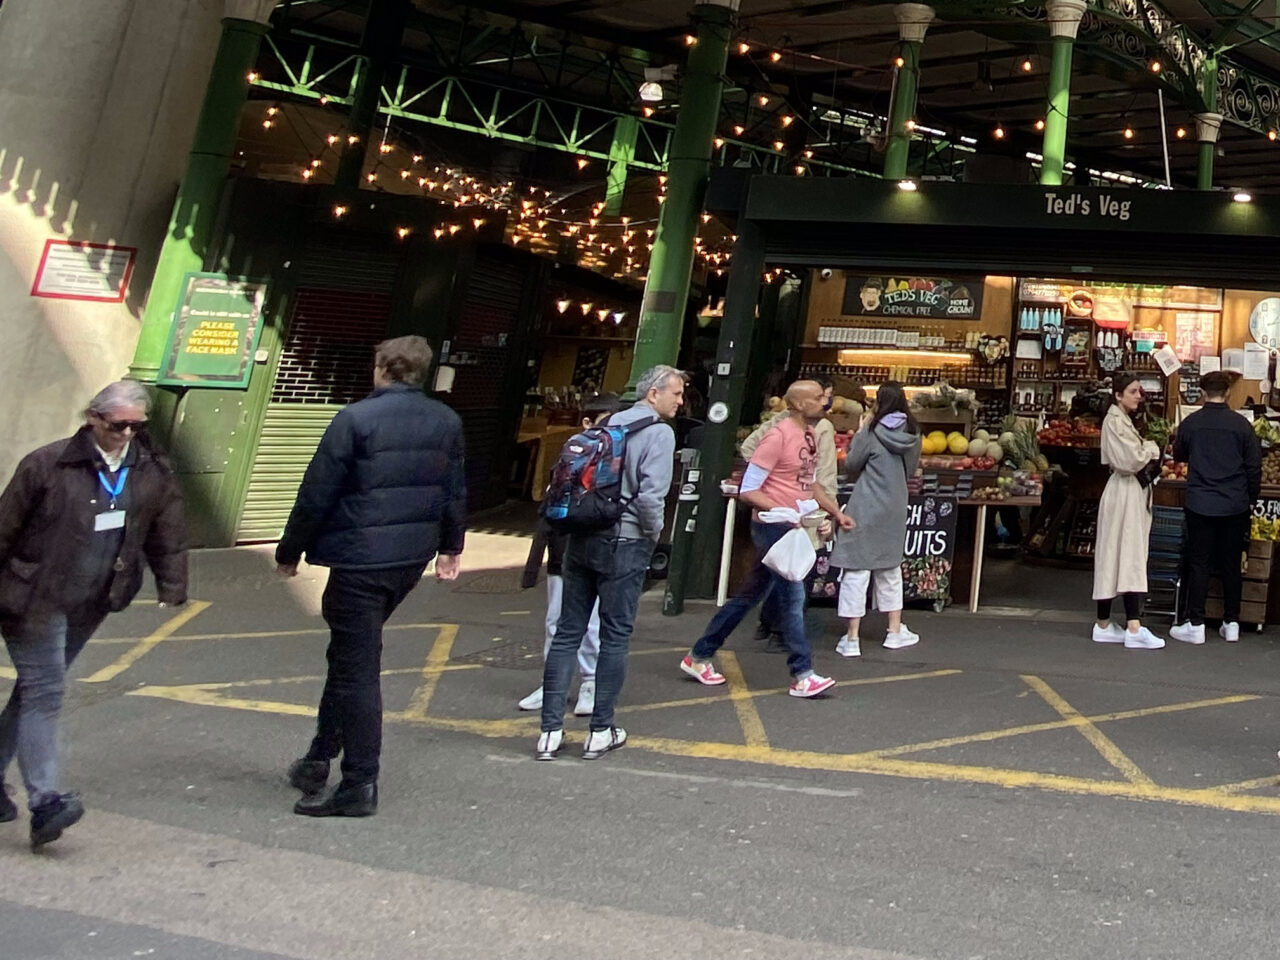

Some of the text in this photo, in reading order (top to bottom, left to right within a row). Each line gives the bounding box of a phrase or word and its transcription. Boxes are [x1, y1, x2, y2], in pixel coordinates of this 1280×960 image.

[1044, 192, 1132, 221] Ted's Veg
[920, 290, 941, 305] VEG
[916, 306, 932, 316] FREE
[199, 321, 236, 330] PLEASE
[191, 329, 240, 339] CONSIDER
[188, 337, 239, 347] WEARING A
[185, 345, 238, 355] FACE MASK
[1253, 499, 1266, 517] 3
[904, 530, 947, 556] UITS
